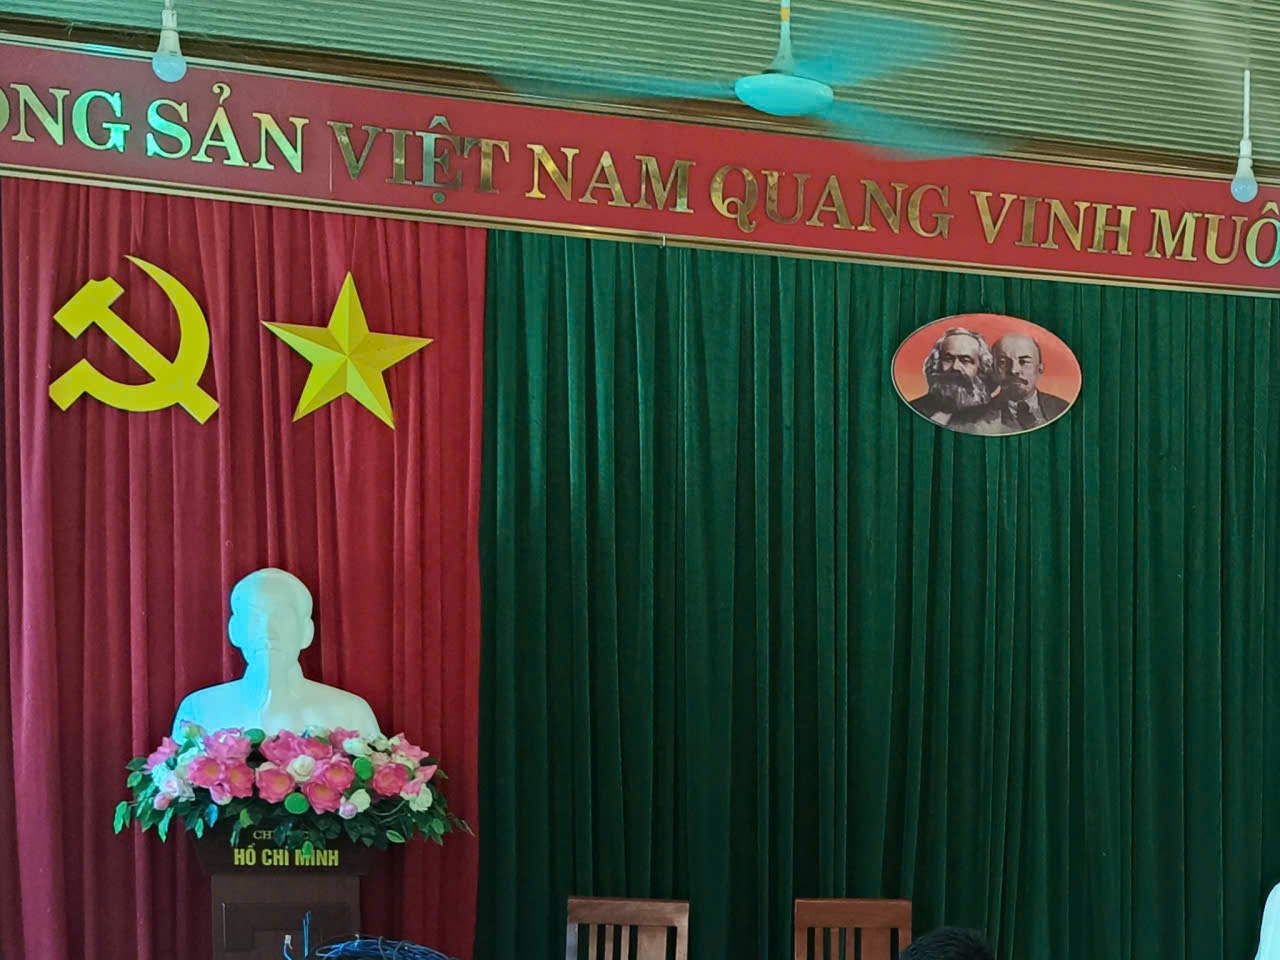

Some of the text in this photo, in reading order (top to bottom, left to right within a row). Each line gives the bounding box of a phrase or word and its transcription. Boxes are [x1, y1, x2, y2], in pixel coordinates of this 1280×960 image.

[0, 83, 130, 153] NG
[146, 83, 309, 173] SẢN
[327, 115, 510, 204] VIỆT
[526, 143, 696, 214] NAM
[710, 164, 954, 240] QUANG
[970, 190, 1137, 256] VINH
[253, 830, 273, 840] CH
[234, 843, 339, 866] HỒ CHÍ MINH
